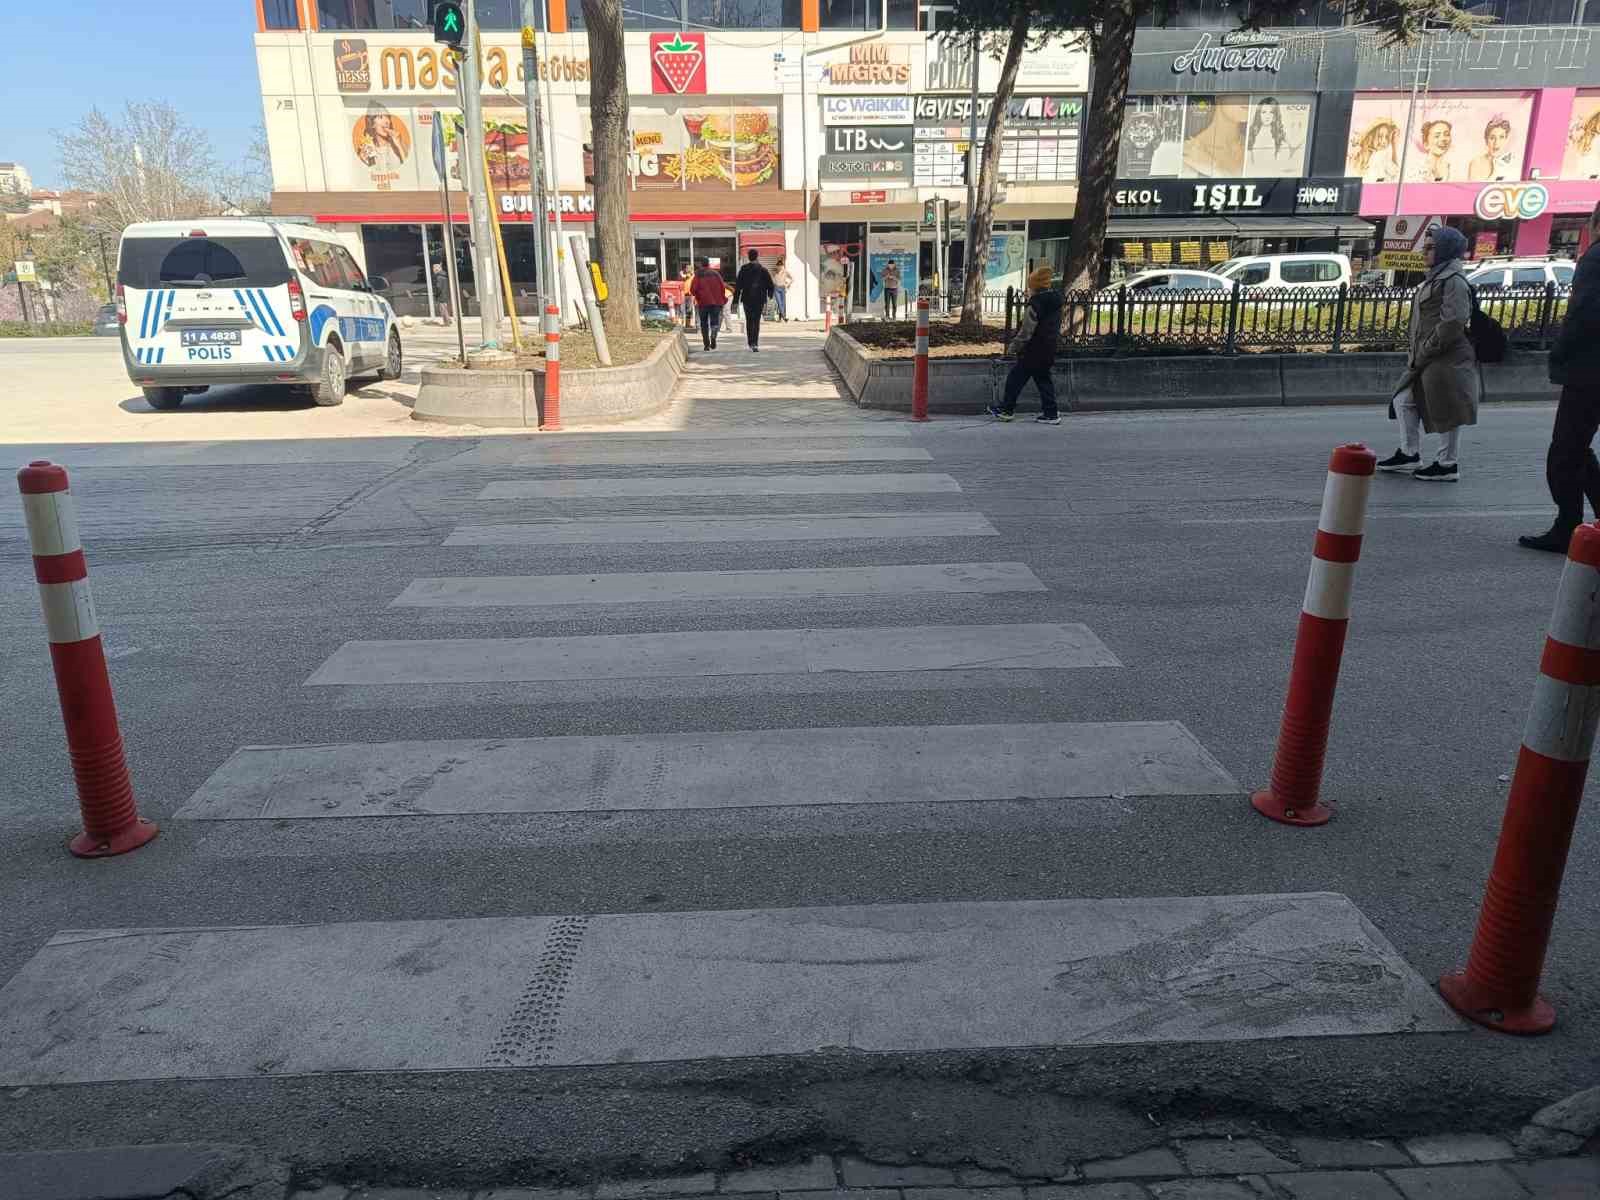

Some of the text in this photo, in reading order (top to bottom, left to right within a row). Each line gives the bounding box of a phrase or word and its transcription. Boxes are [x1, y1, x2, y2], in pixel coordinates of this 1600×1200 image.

[1172, 32, 1286, 73] Amazon
[336, 70, 369, 82] massa
[380, 47, 510, 89] masa
[827, 99, 847, 112] LC
[834, 129, 867, 152] LTB
[1115, 189, 1162, 204] EKOL
[1193, 184, 1264, 210] IŞIL
[1476, 183, 1549, 220] eve
[188, 347, 232, 359] POLİS
